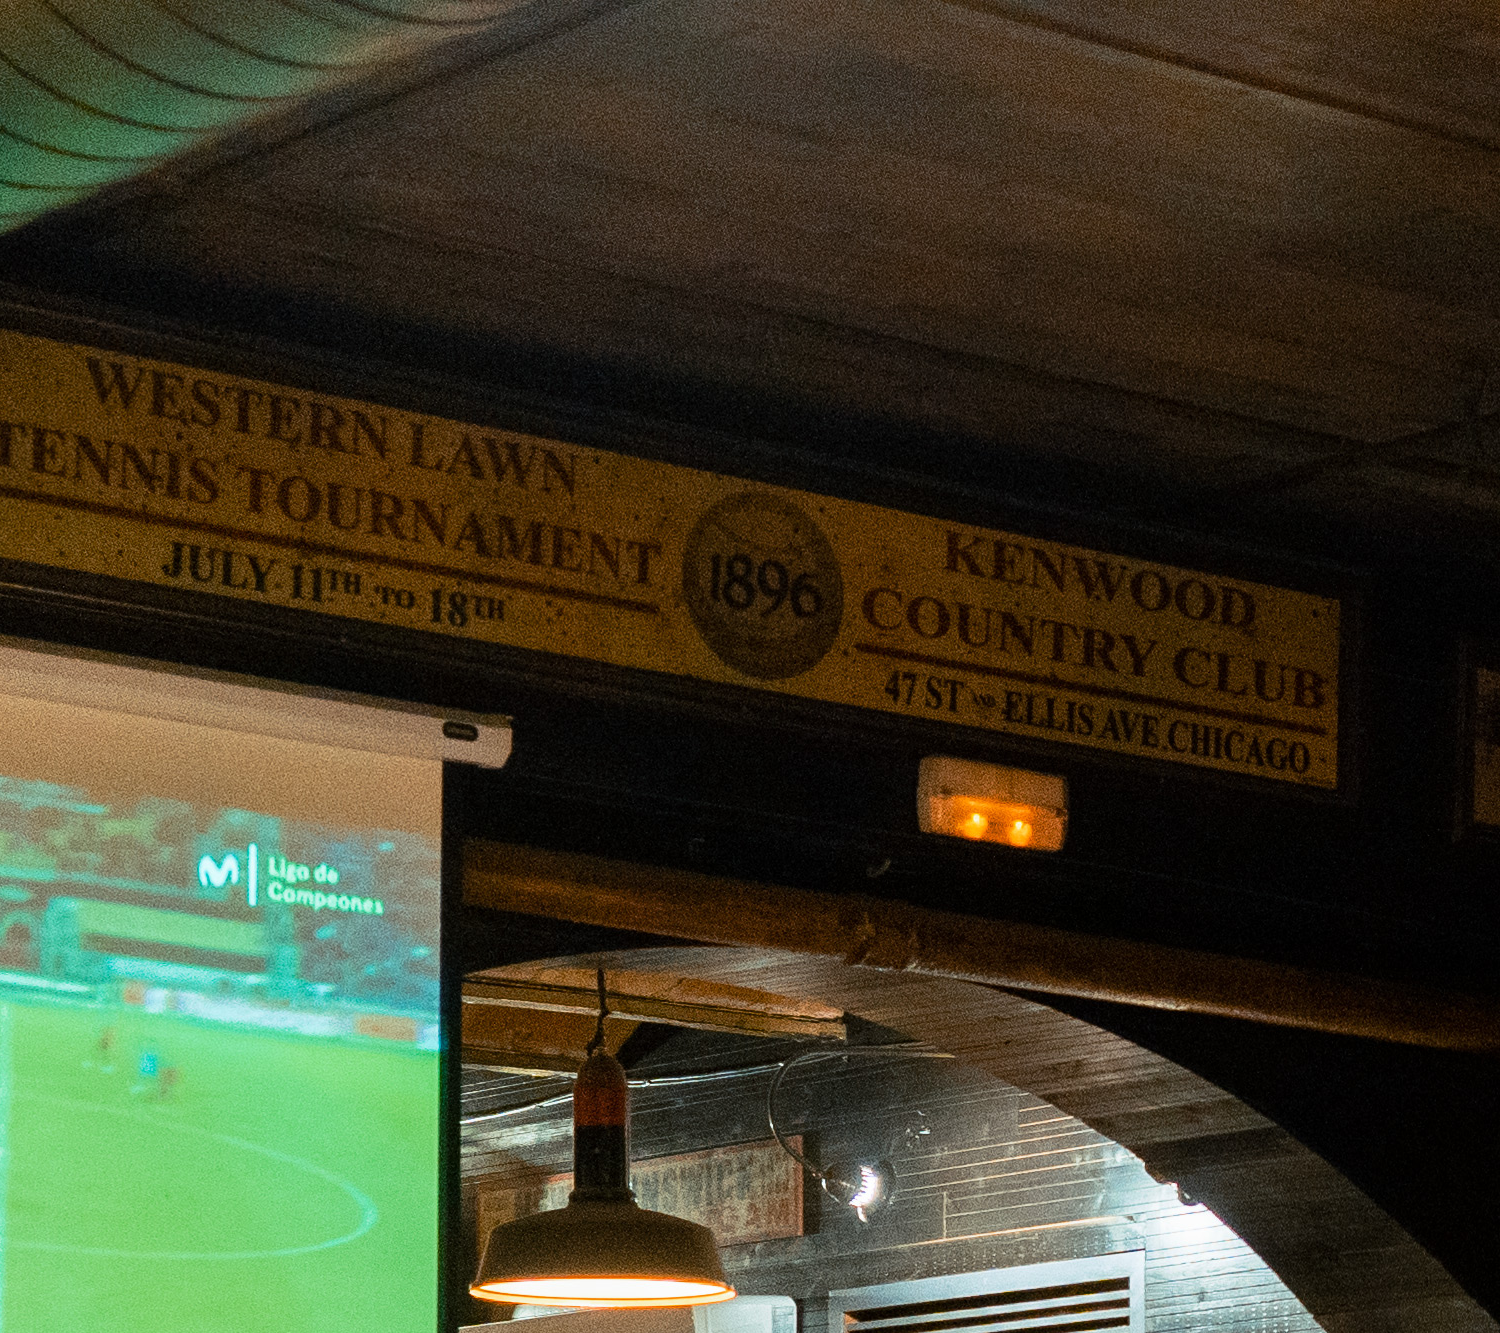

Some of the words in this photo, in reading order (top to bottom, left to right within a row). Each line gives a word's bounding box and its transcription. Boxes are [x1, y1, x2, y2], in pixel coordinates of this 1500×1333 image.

[86, 355, 390, 458] WESTERN
[409, 421, 577, 497] LAWN
[161, 540, 280, 594] JULY
[229, 465, 663, 589] TOURNAMENT
[708, 552, 824, 619] 1896
[942, 528, 1258, 637] KENWOOD
[861, 586, 1158, 679] COUNTRY
[1173, 645, 1328, 712] CLUB
[885, 672, 917, 705] 47
[923, 678, 964, 713] ST
[1005, 692, 1095, 737] ELLIS
[1167, 722, 1311, 773] CHICAGO
[199, 854, 239, 887] M
[313, 863, 339, 885] de
[268, 882, 384, 916] Campeones
